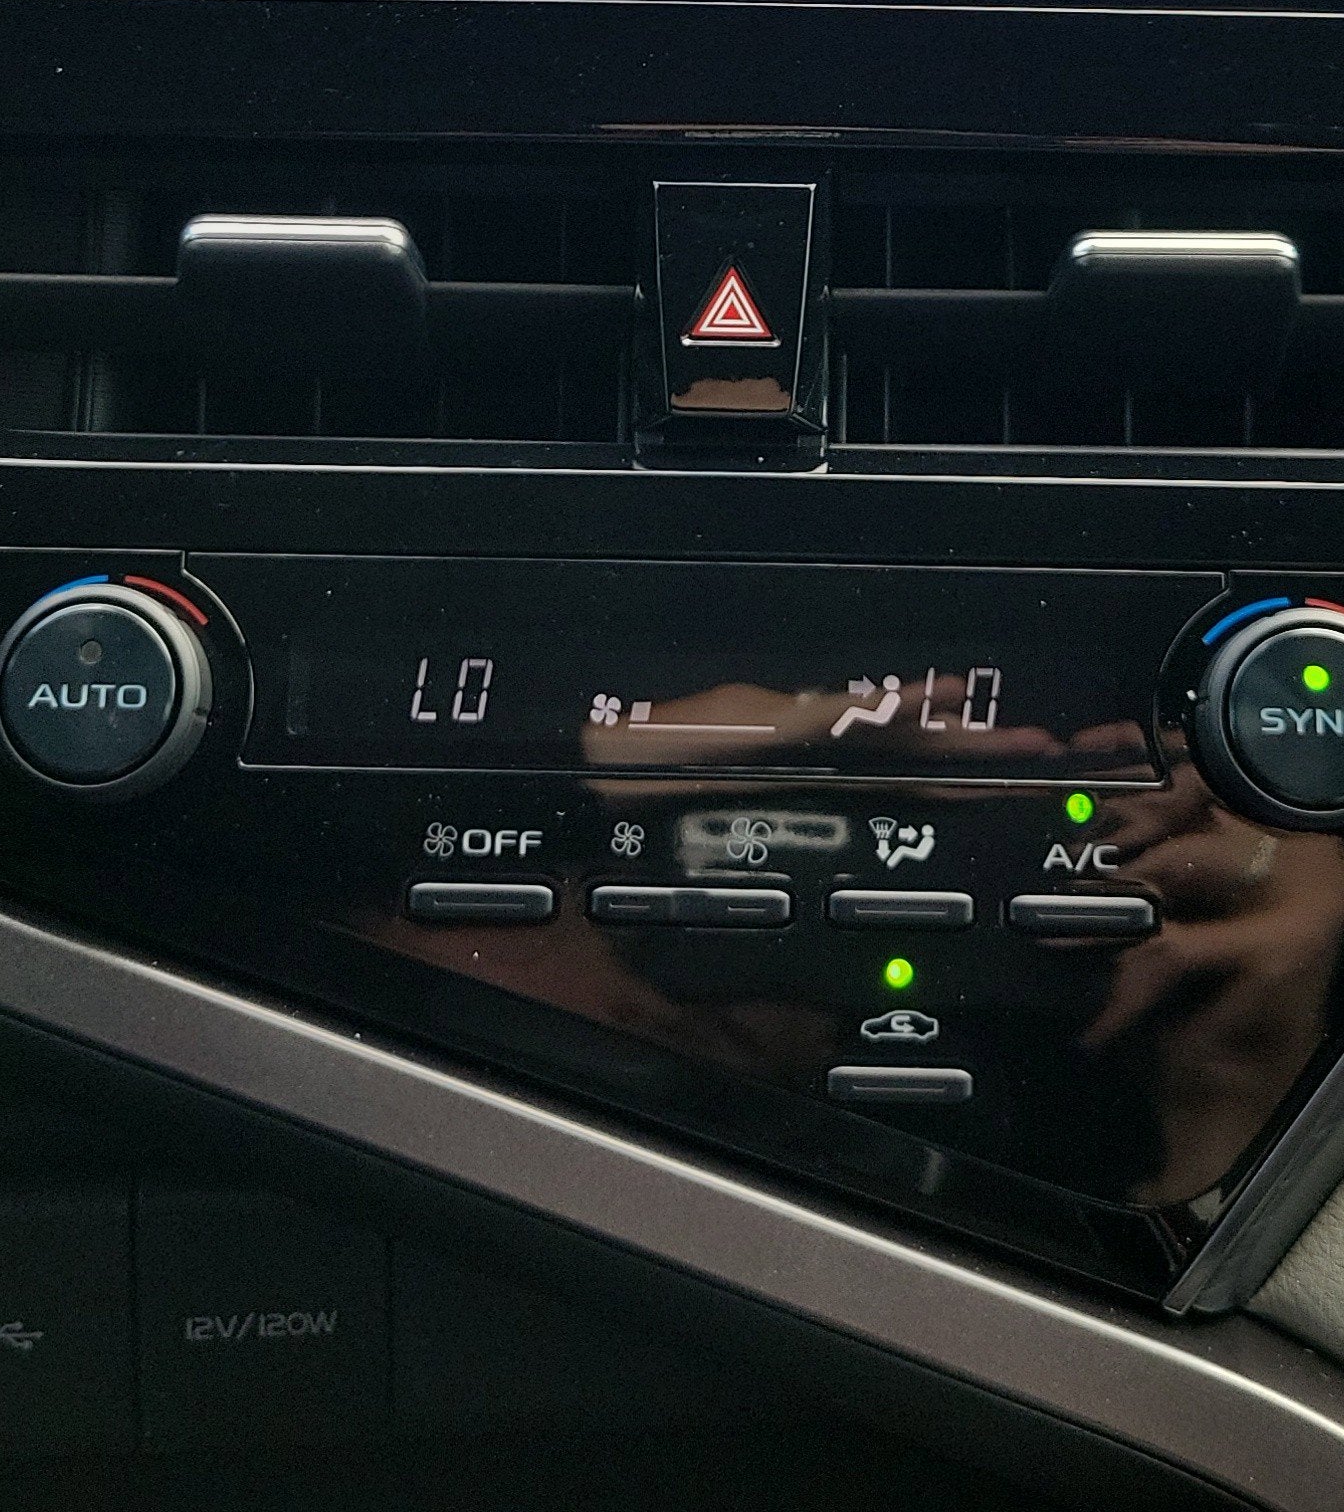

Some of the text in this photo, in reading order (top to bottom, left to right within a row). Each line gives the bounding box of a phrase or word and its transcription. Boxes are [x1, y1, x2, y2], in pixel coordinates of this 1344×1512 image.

[27, 683, 148, 710] AUTO
[411, 657, 494, 722] LO
[919, 667, 1002, 731] LO
[462, 829, 543, 858] OFF
[1043, 843, 1119, 872] A/C
[185, 1311, 339, 1342] 12V/120W
